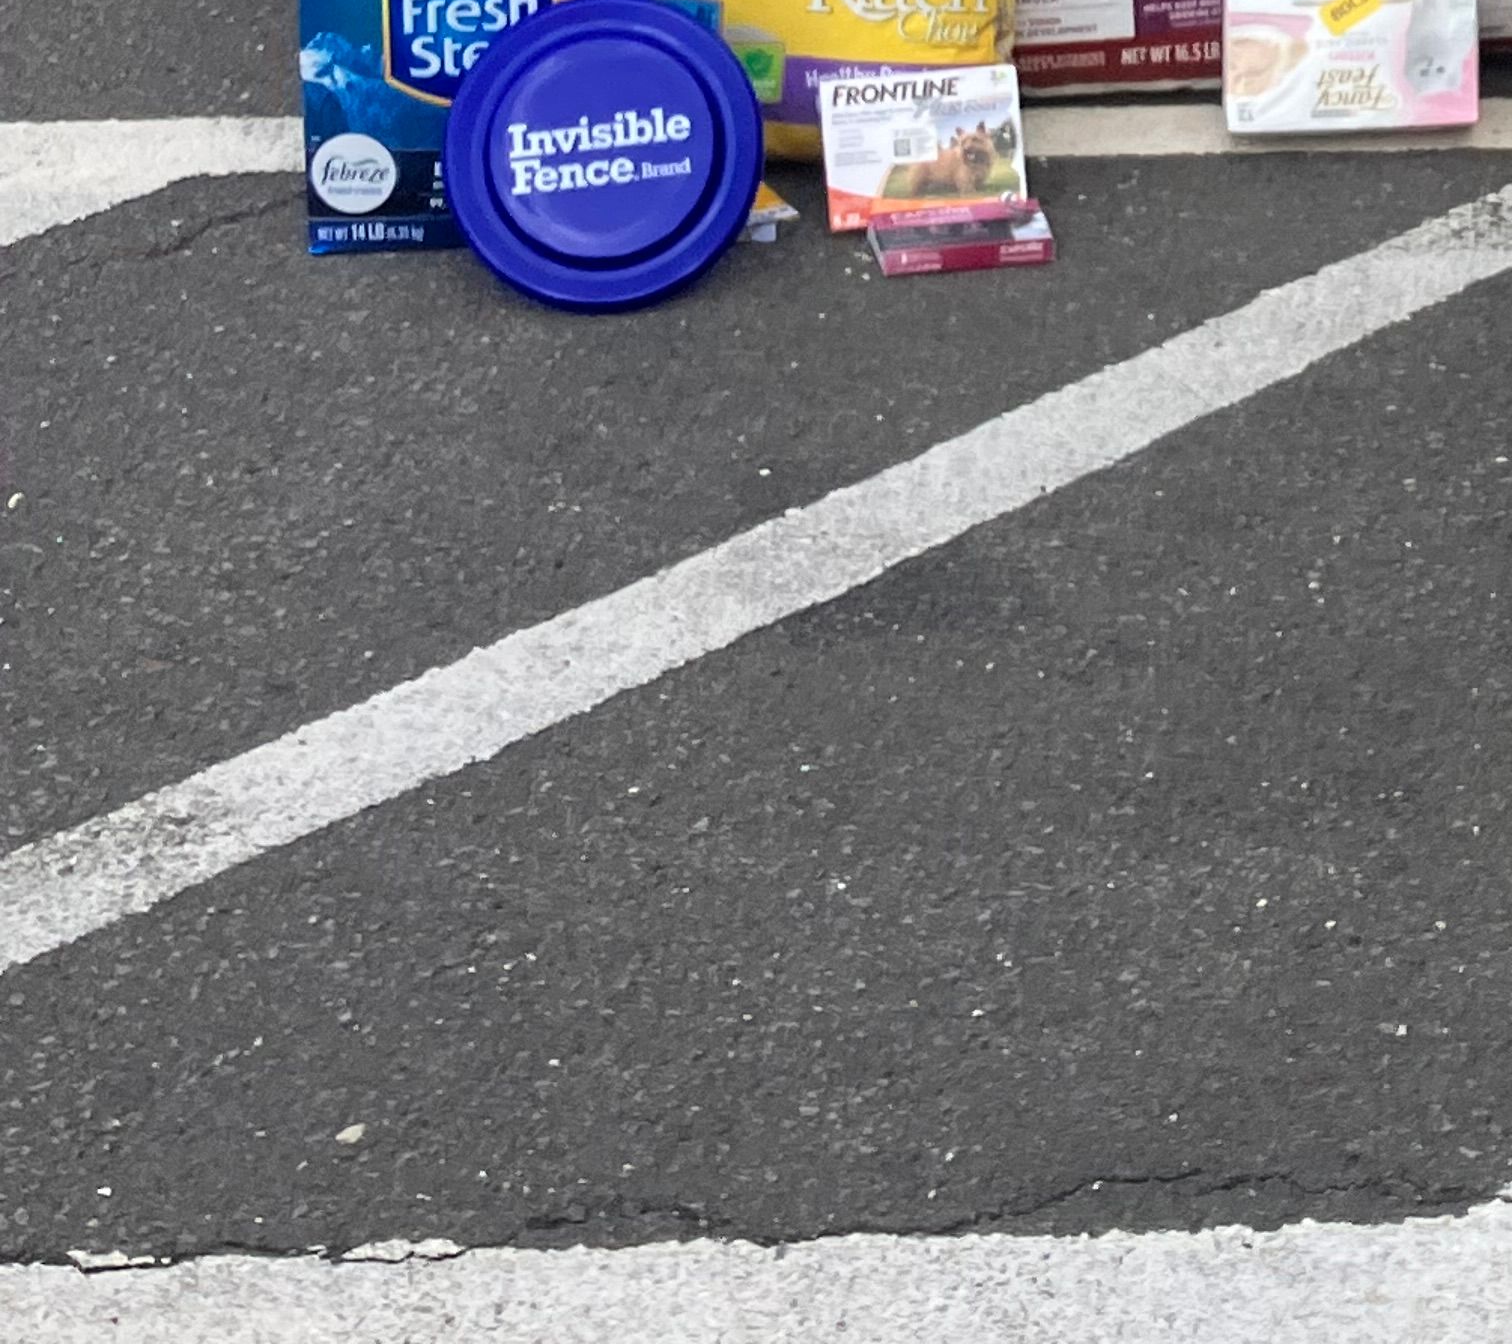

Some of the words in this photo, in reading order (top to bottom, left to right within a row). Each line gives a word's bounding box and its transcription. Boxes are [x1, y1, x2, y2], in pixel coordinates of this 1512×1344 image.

[832, 76, 961, 108] FRONTLINE
[508, 107, 692, 160] Invisible
[509, 157, 635, 196] Fence
[640, 157, 692, 180] Brand
